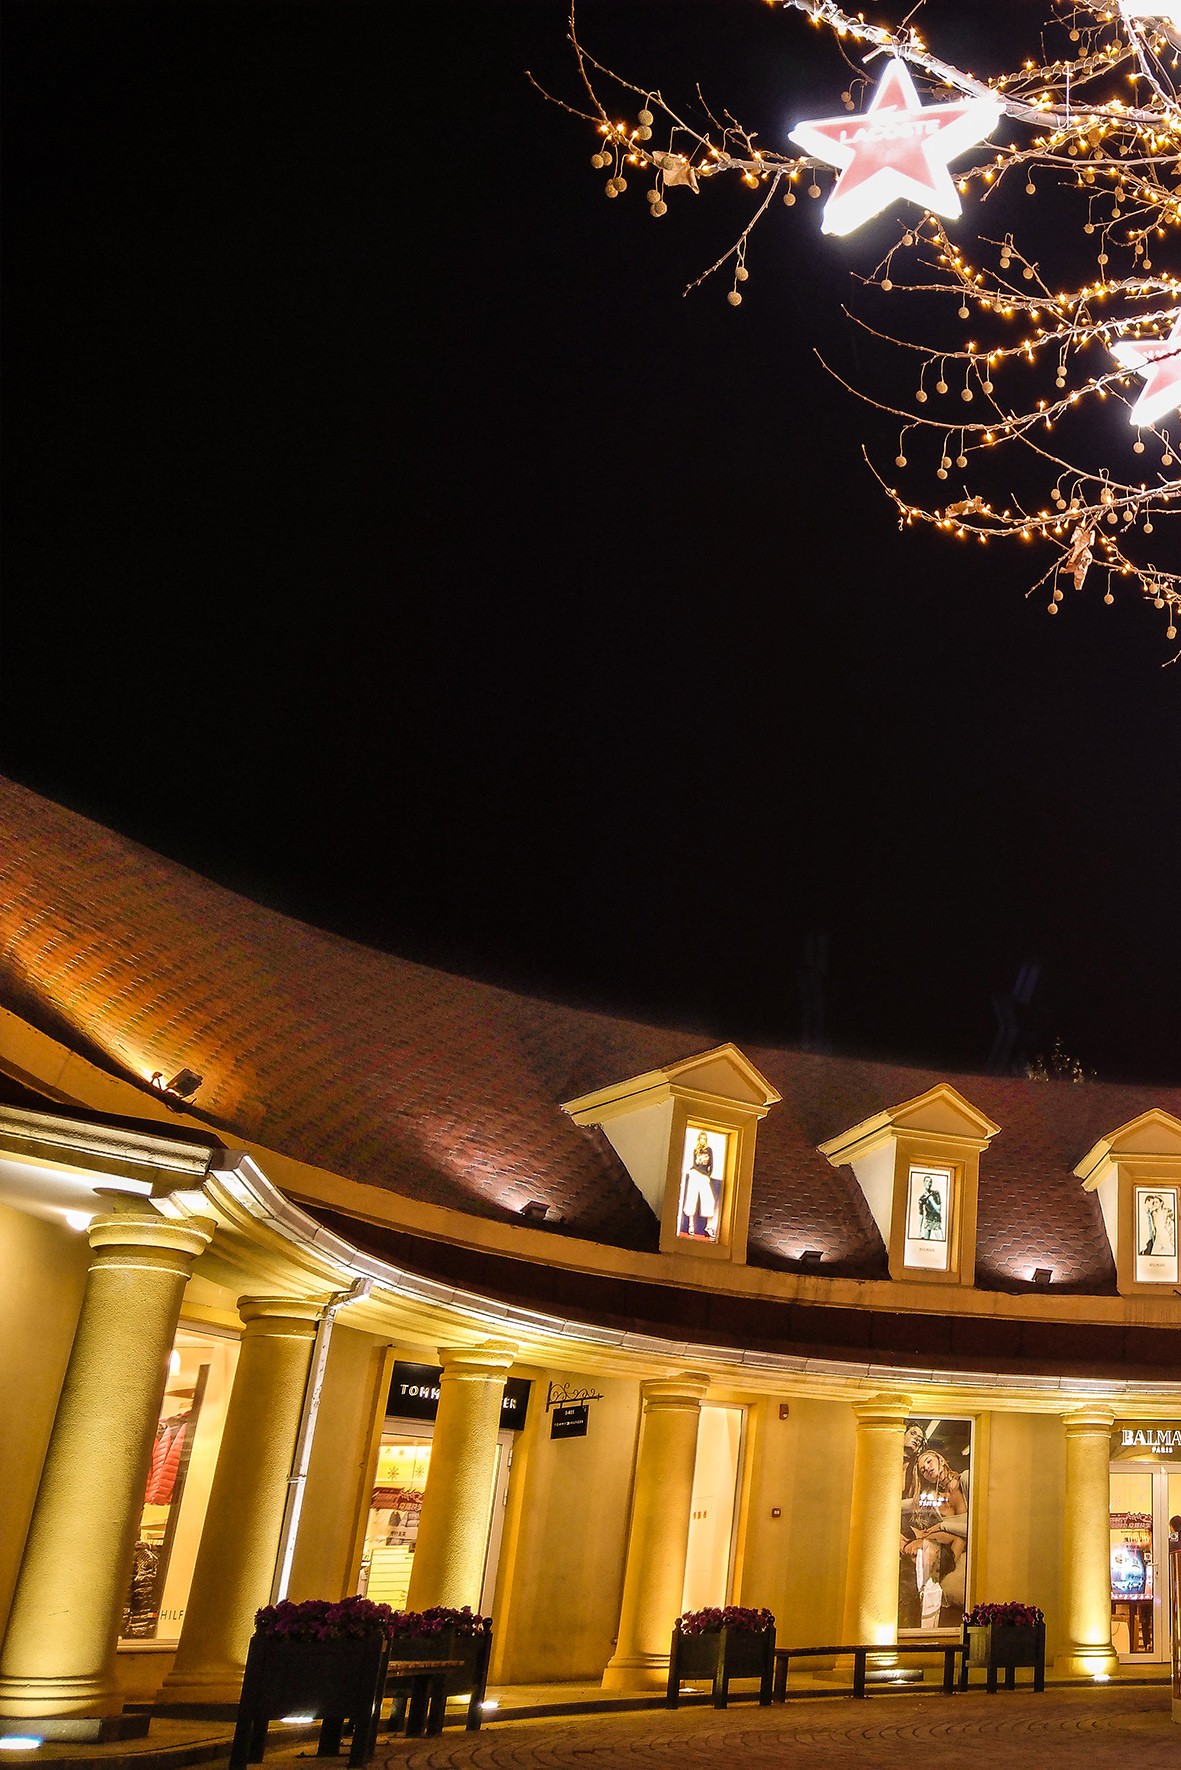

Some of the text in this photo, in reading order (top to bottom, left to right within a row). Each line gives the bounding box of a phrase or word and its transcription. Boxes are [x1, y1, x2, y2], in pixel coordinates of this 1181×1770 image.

[399, 1384, 441, 1400] TOMM
[1151, 1446, 1173, 1454] PARIS
[160, 1609, 185, 1621] HILF
